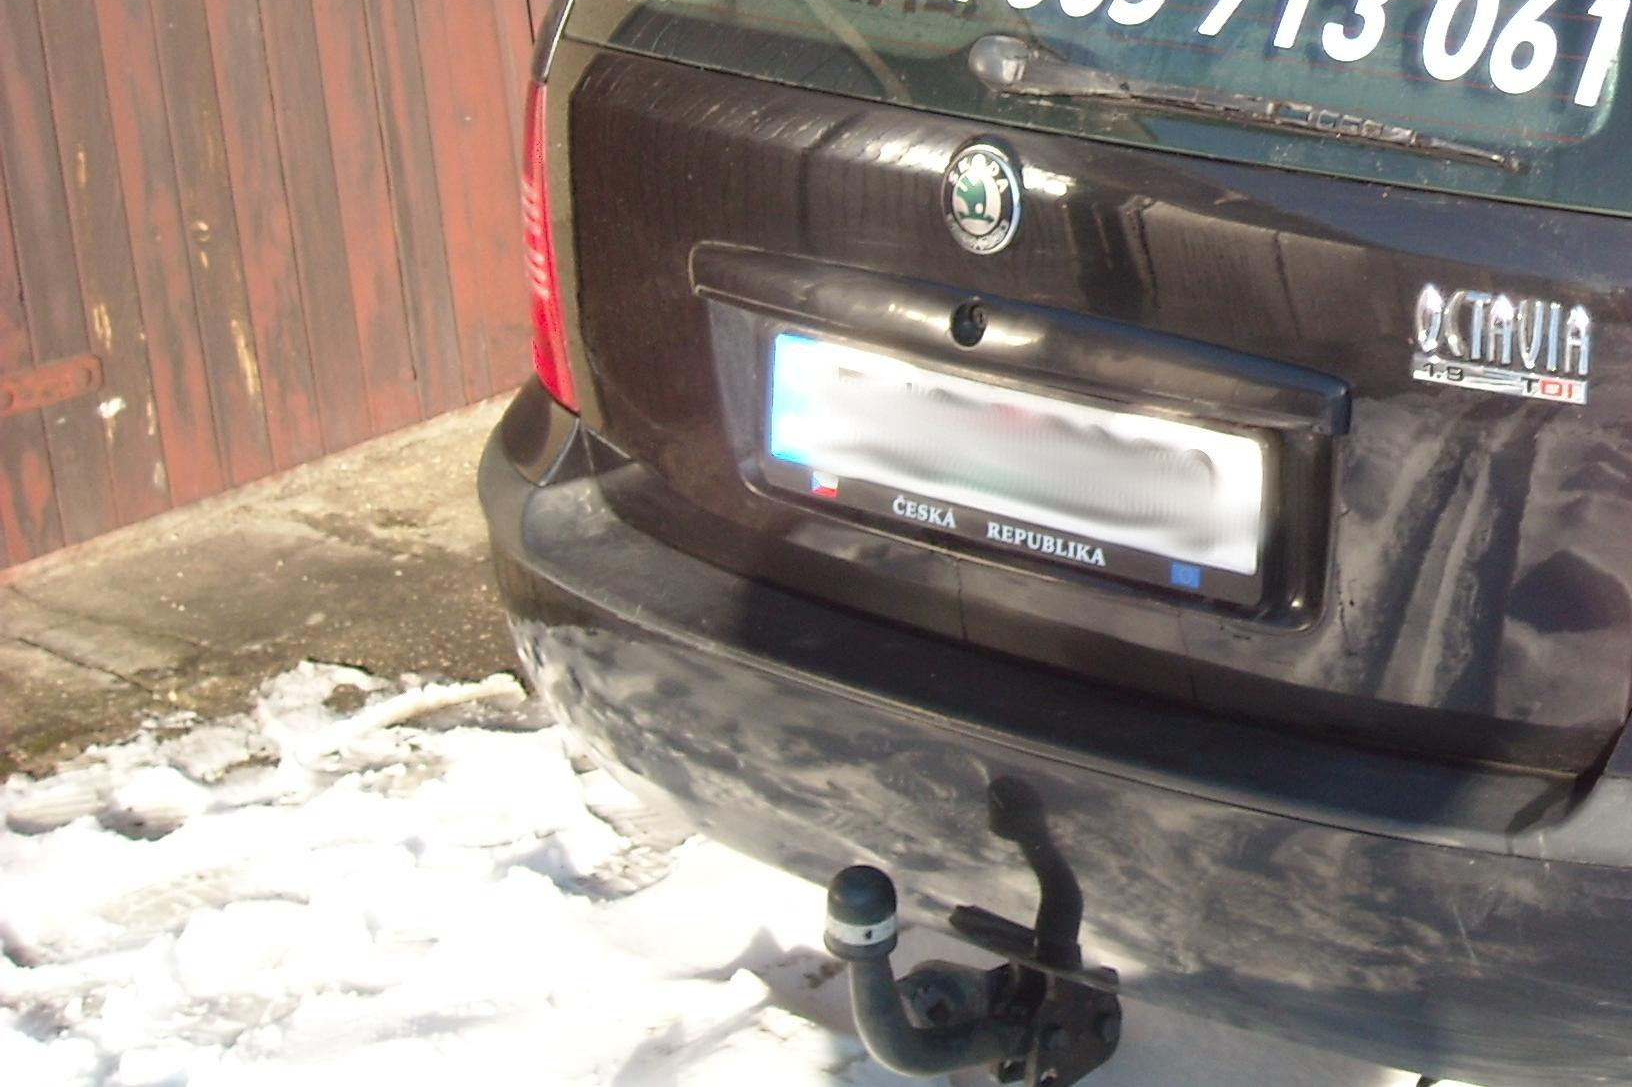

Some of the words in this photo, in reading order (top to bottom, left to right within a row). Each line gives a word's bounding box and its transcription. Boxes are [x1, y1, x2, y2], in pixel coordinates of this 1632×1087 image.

[1415, 283, 1591, 375] OCTAVIA
[1521, 377, 1574, 399] TDI
[891, 495, 957, 529] ČESKÁ
[986, 520, 1106, 566] REPUBLIKA
